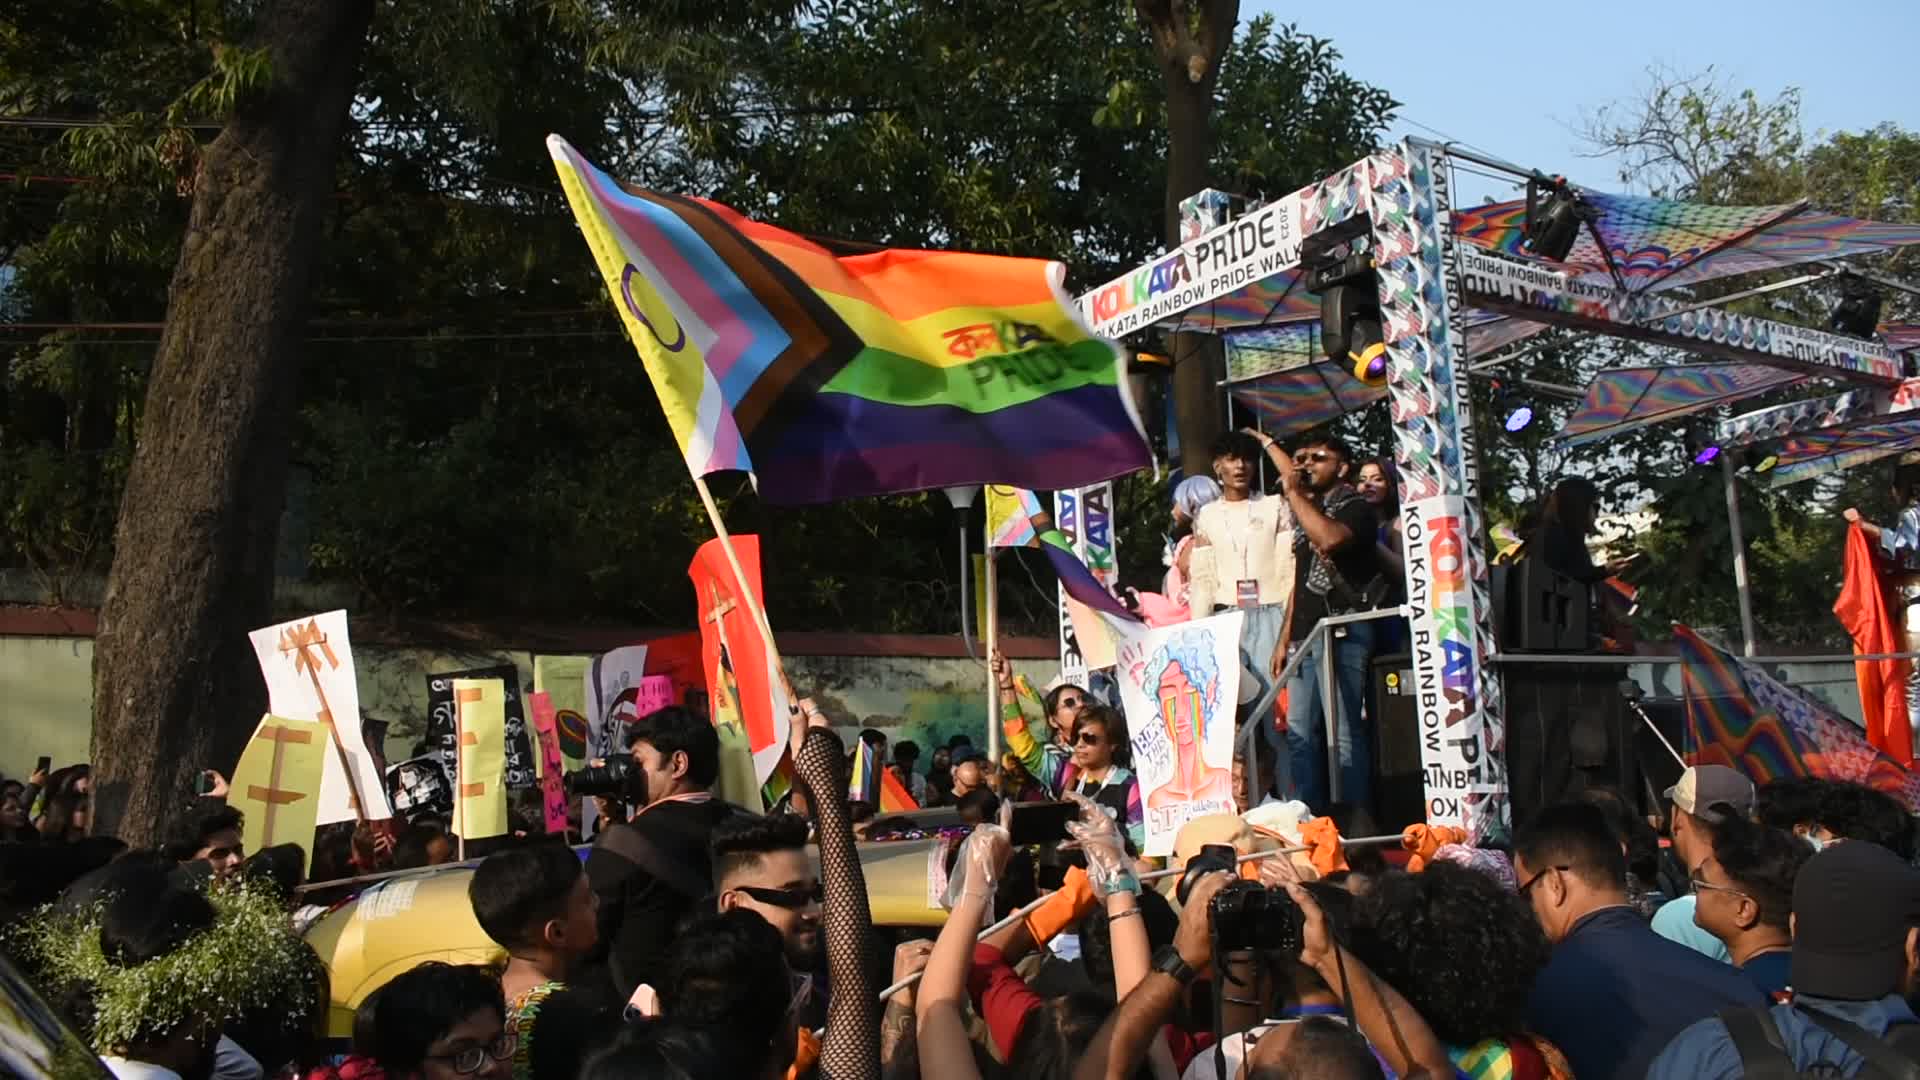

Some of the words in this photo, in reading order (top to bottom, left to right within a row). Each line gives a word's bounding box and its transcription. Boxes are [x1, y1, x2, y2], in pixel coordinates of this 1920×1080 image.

[1092, 253, 1192, 325] KOLKATA
[1195, 211, 1276, 277] PRIDE
[1280, 206, 1290, 240] 2023
[1142, 283, 1205, 322] RAINBOW
[1211, 263, 1256, 294] PRIDE
[1260, 242, 1302, 273] WALK
[1440, 222, 1463, 335] RAINBOW
[1465, 255, 1503, 276] PRIDE
[1507, 267, 1562, 290] RAINBOW
[1452, 343, 1472, 417] PRIDE
[1461, 428, 1478, 493] WALK
[1405, 506, 1426, 621] KOLKATA
[1427, 516, 1476, 729] KOLKATA
[1415, 630, 1441, 752] RAINBOW
